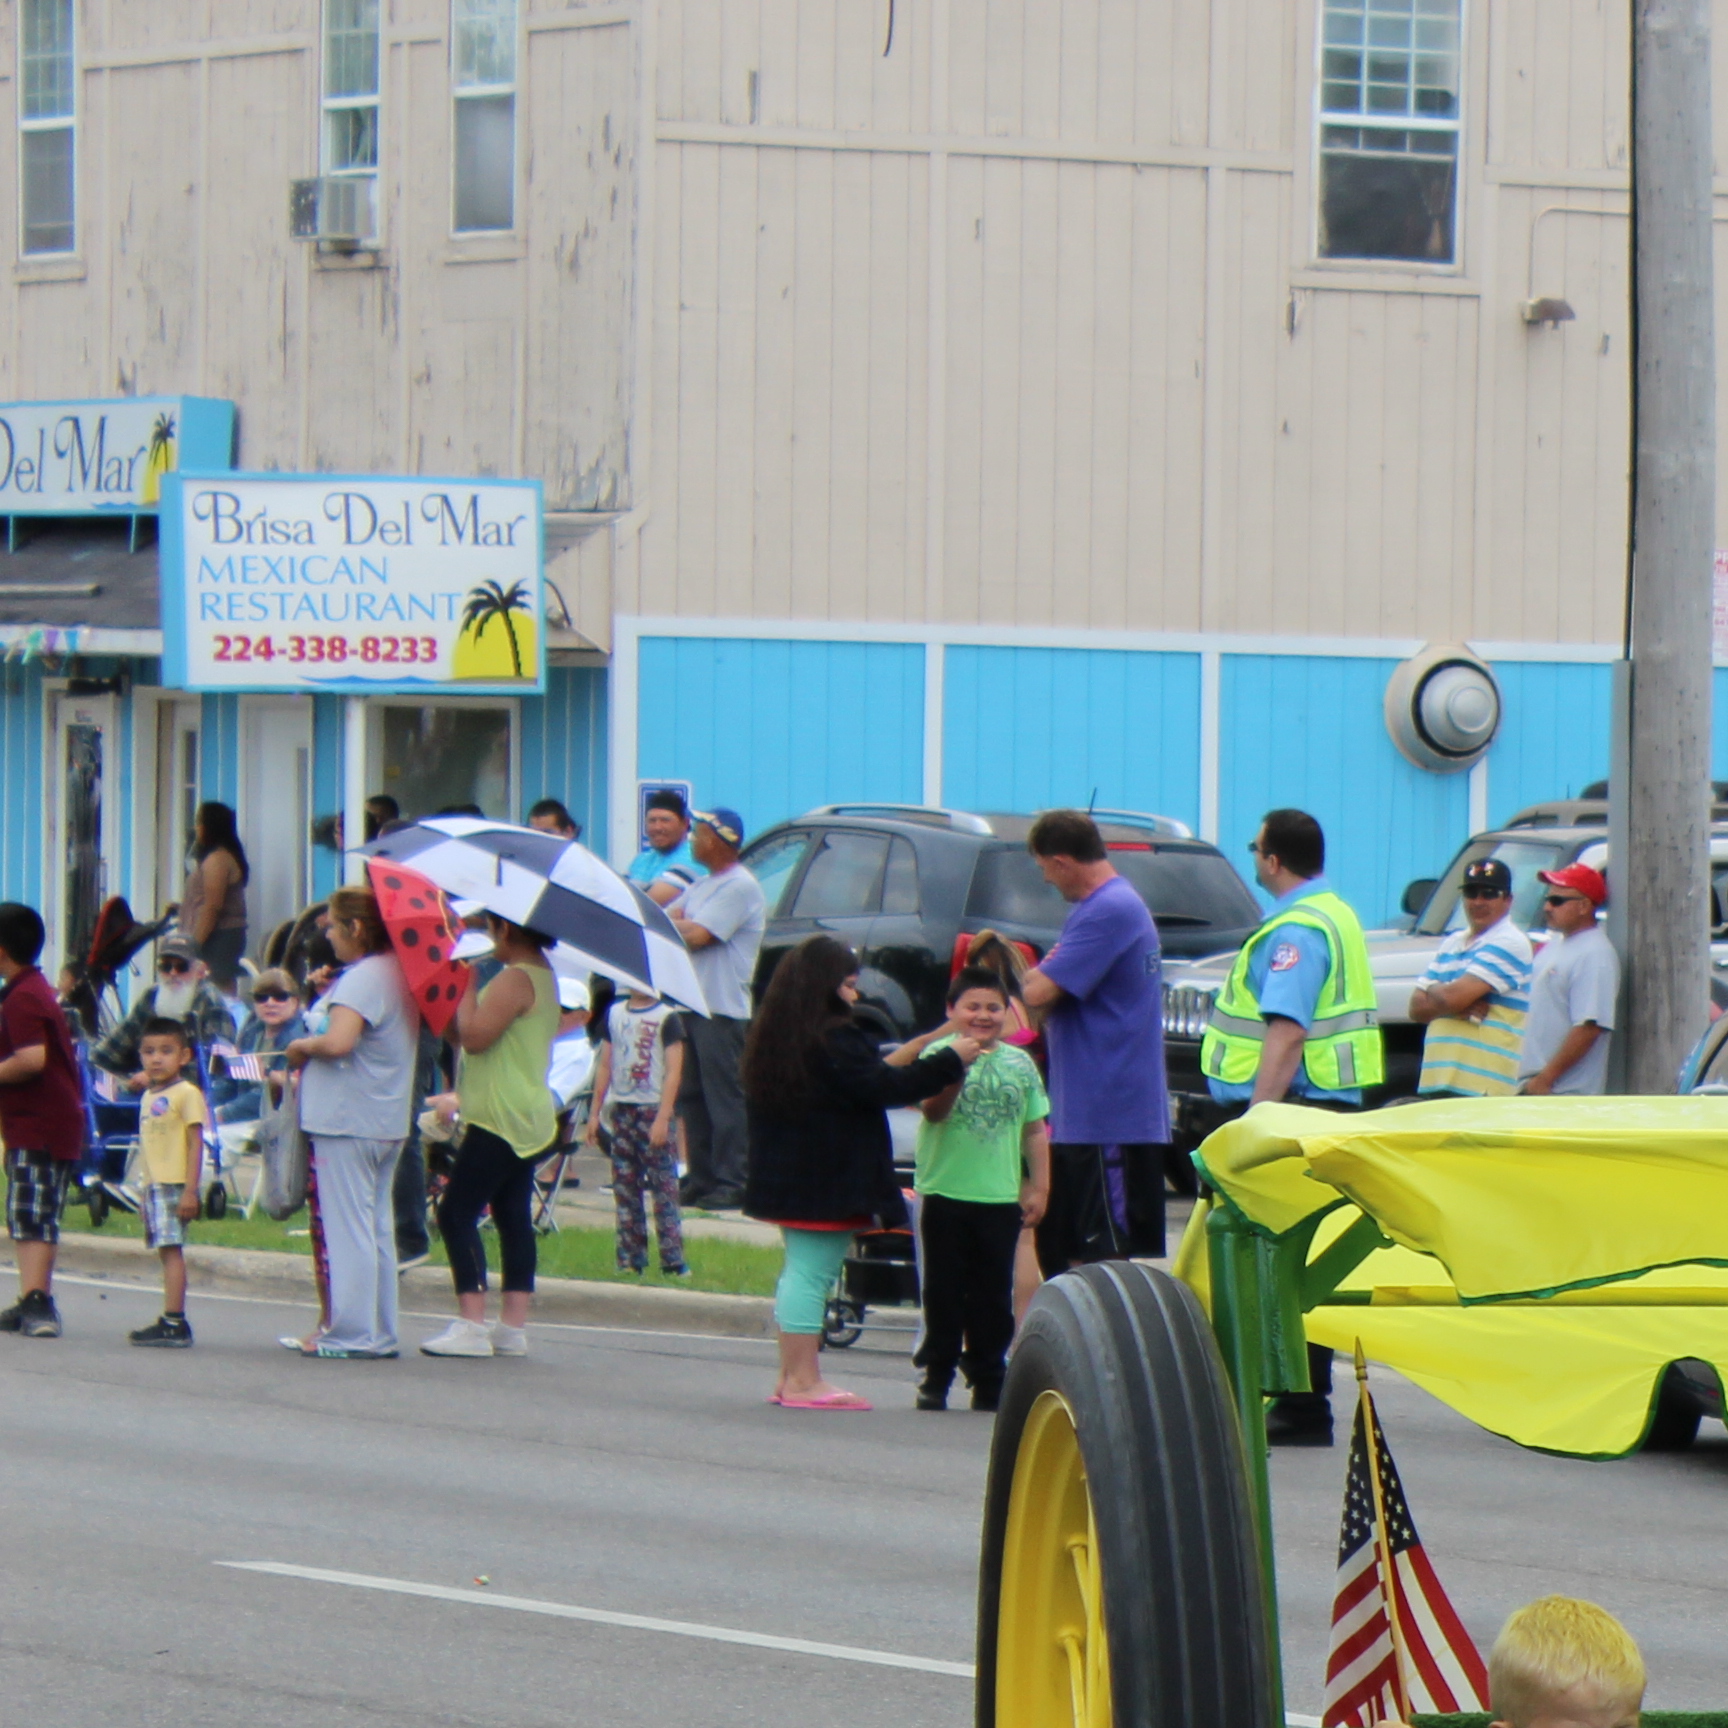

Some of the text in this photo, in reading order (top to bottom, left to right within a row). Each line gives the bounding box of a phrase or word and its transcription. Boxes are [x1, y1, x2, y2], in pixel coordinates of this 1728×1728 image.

[0, 415, 147, 495] el Mar
[192, 490, 528, 548] Brisa Del Mar
[197, 555, 389, 585] MEXICAN
[200, 591, 463, 623] RESTAURANT
[212, 634, 439, 663] 224-338-8233
